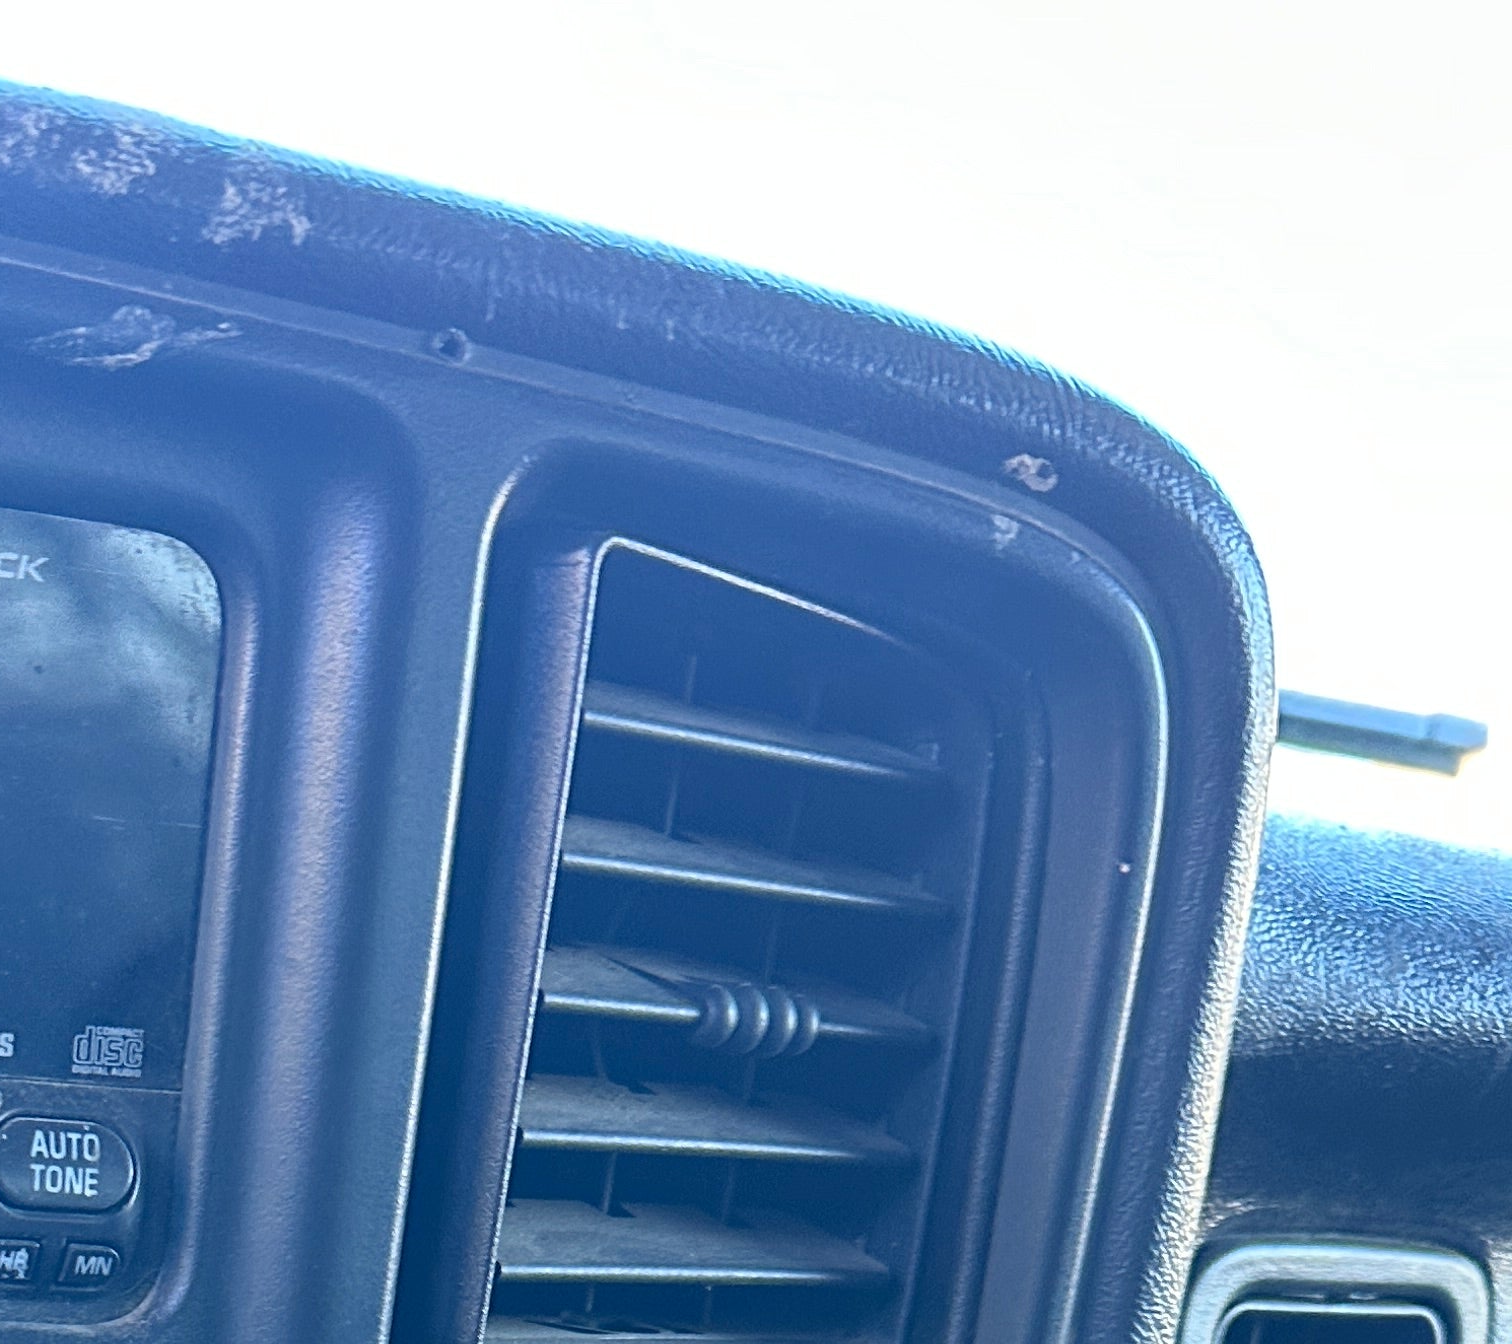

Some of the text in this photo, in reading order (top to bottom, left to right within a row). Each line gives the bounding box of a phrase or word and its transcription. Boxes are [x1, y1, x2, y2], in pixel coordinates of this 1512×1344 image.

[30, 1129, 100, 1162] AUTO
[30, 1164, 99, 1196] TONE
[74, 1255, 113, 1276] MN
